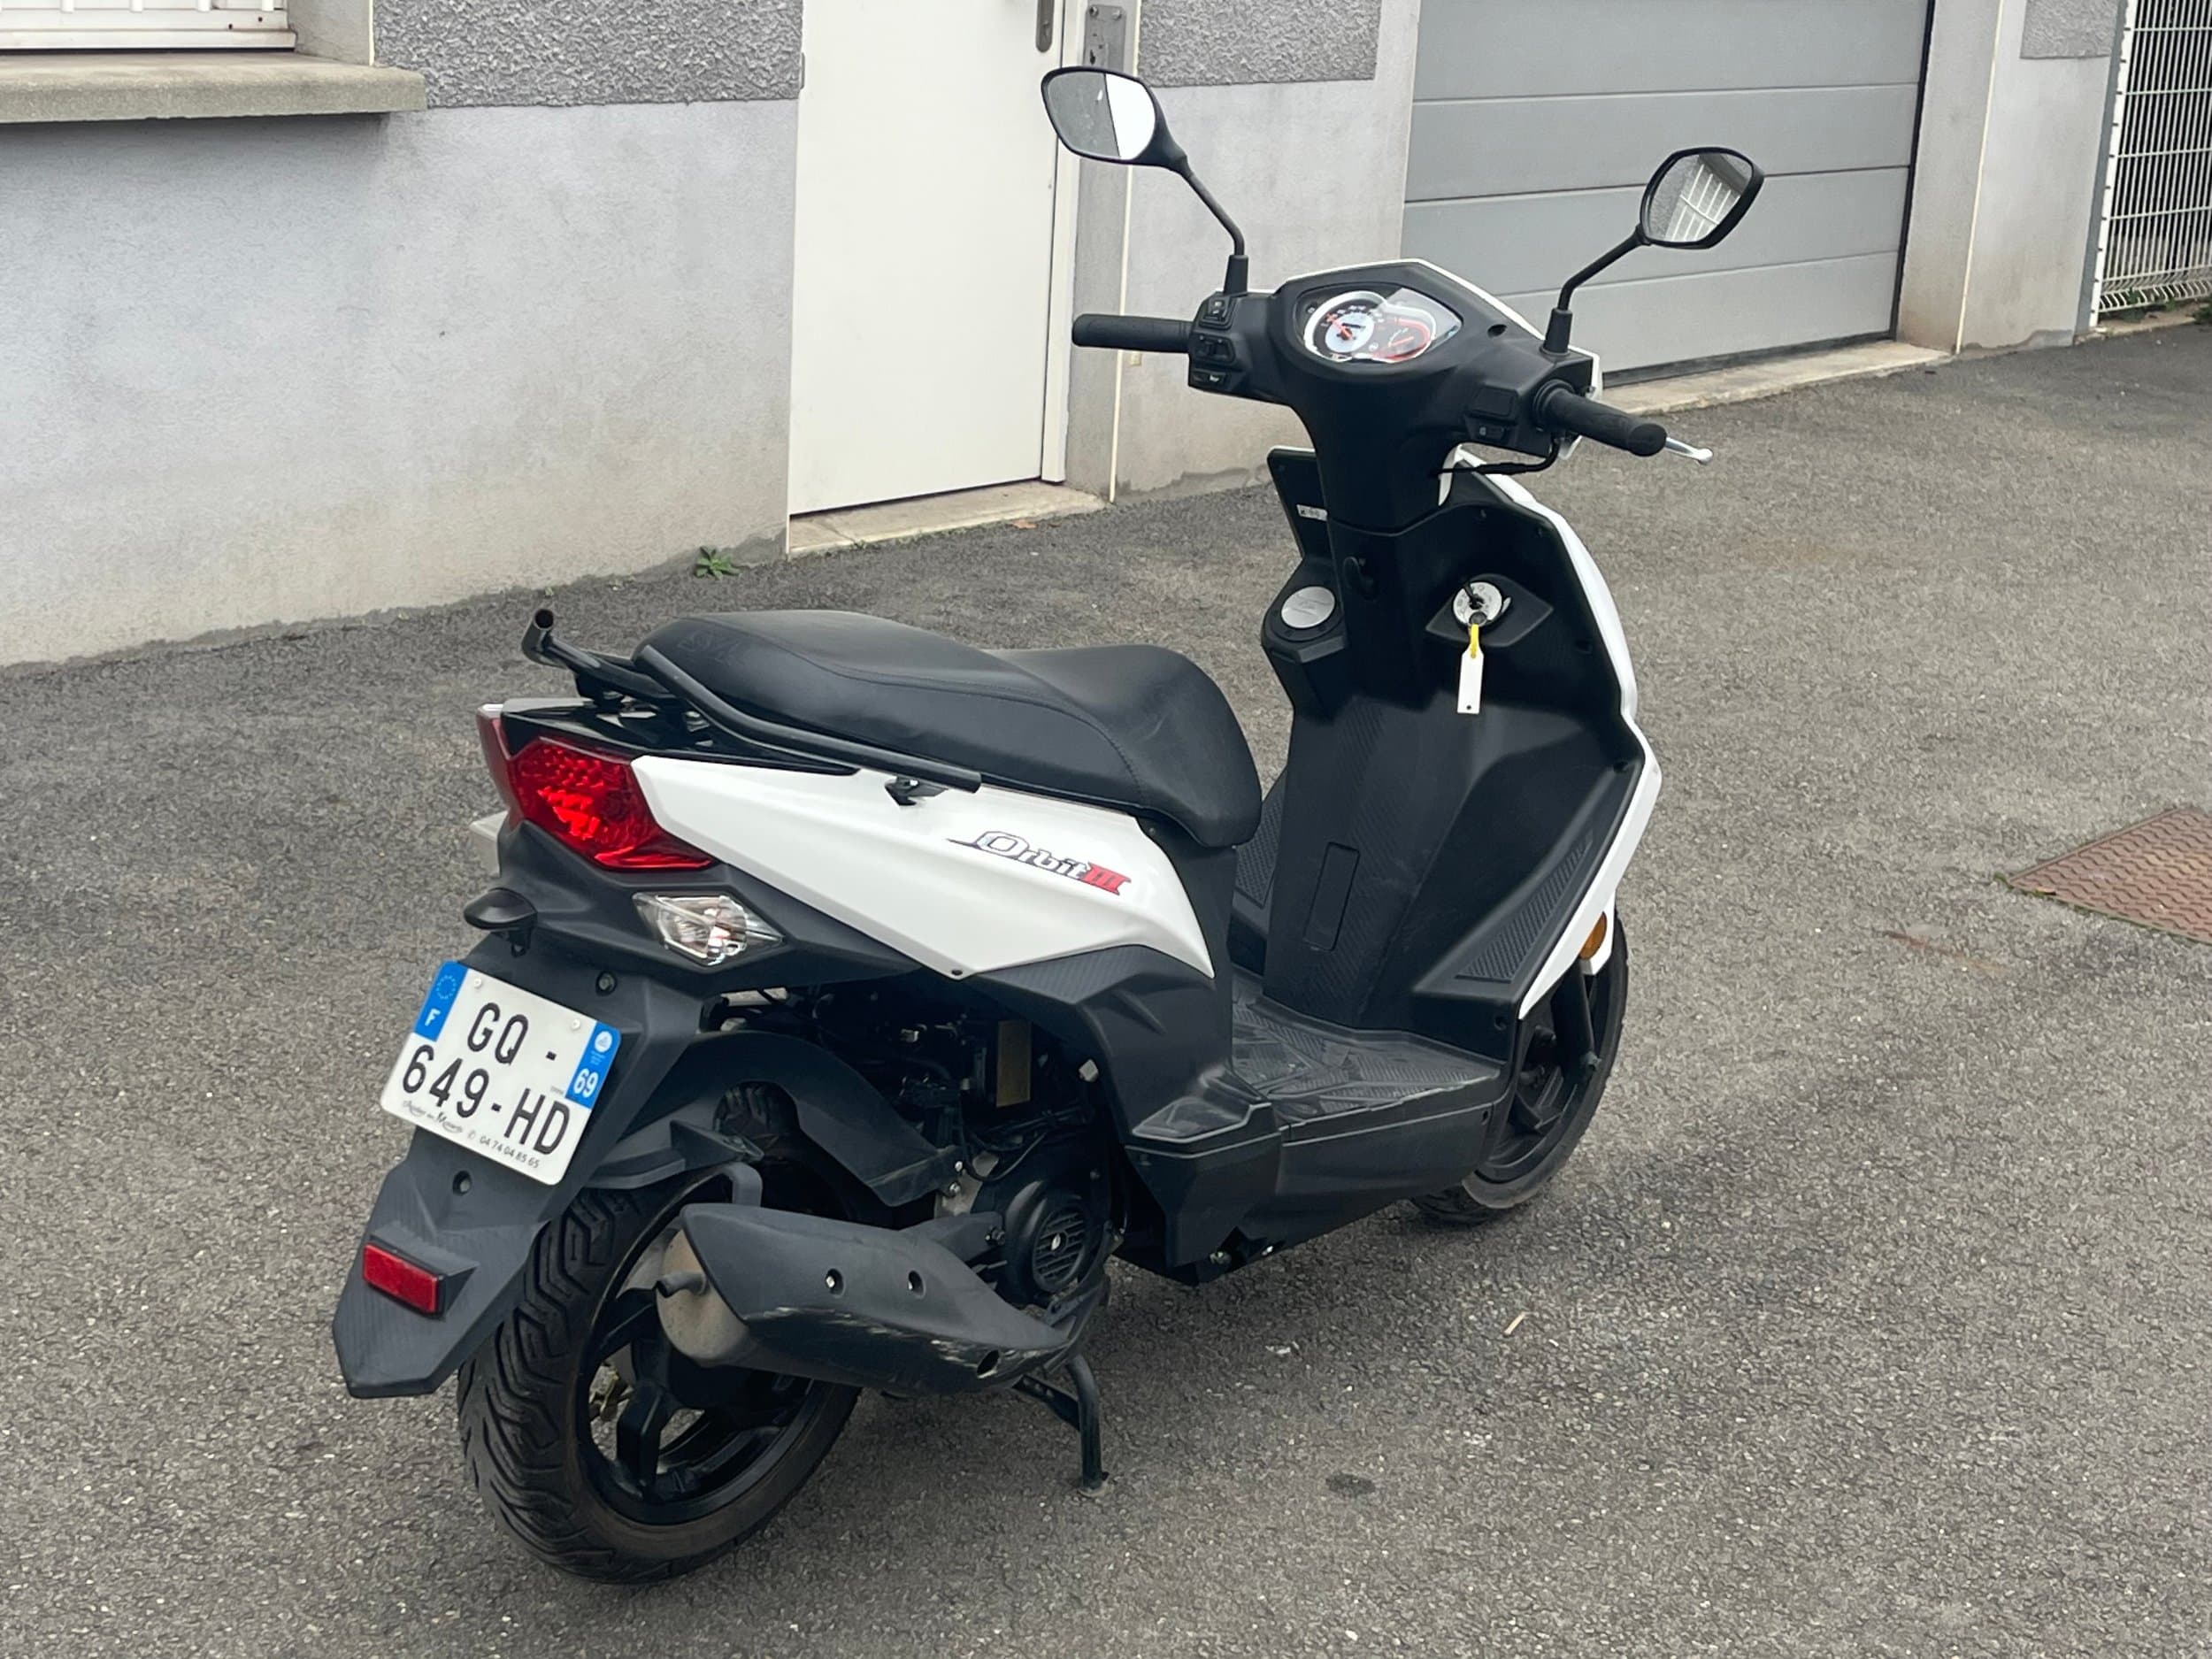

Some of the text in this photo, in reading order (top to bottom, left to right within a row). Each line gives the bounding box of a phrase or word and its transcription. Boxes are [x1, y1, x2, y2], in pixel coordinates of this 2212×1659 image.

[947, 831, 1090, 879] Orbit
[425, 1008, 441, 1026] F
[573, 1068, 599, 1097] 69
